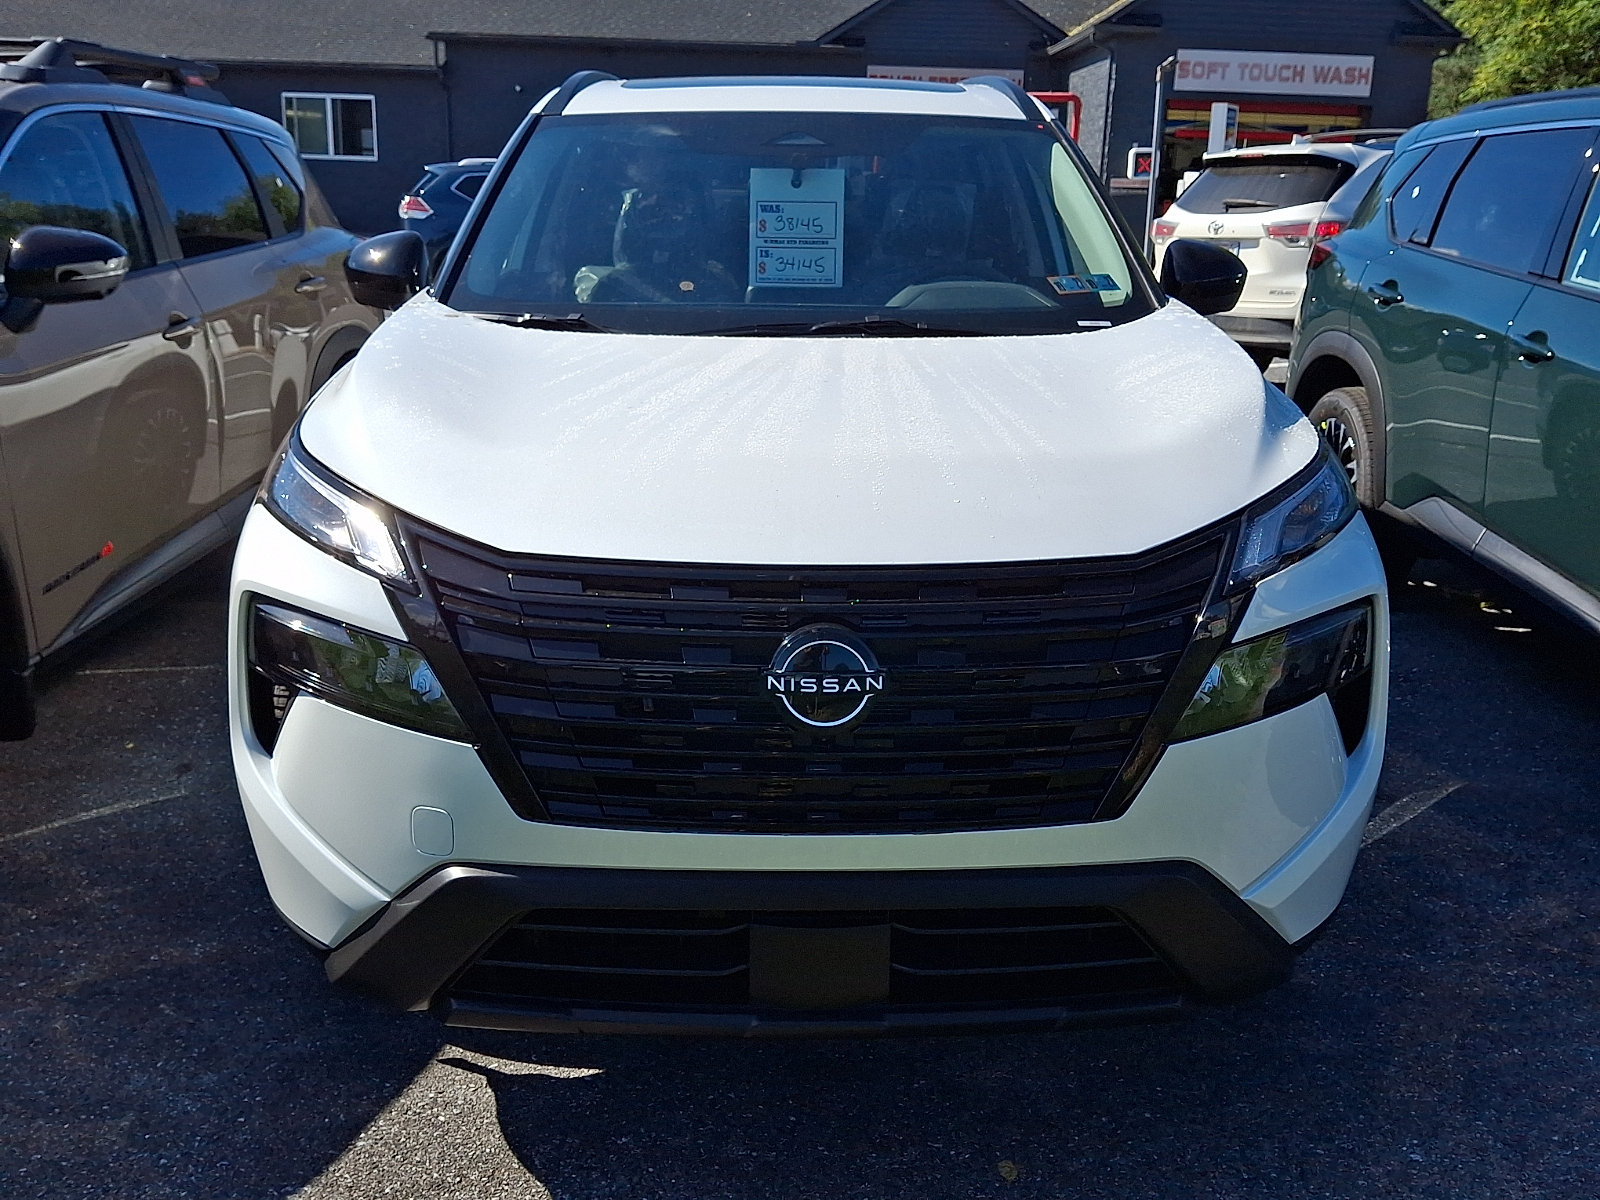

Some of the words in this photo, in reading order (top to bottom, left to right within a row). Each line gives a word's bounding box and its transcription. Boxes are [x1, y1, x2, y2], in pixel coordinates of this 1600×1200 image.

[1177, 60, 1230, 80] SOFT
[1238, 62, 1305, 83] TOUCH
[1313, 65, 1371, 85] WASH
[759, 204, 784, 213] WAS:
[774, 215, 823, 233] 38145
[759, 250, 773, 258] IS:
[775, 256, 825, 273] 34145
[767, 675, 883, 693] NISSAN
